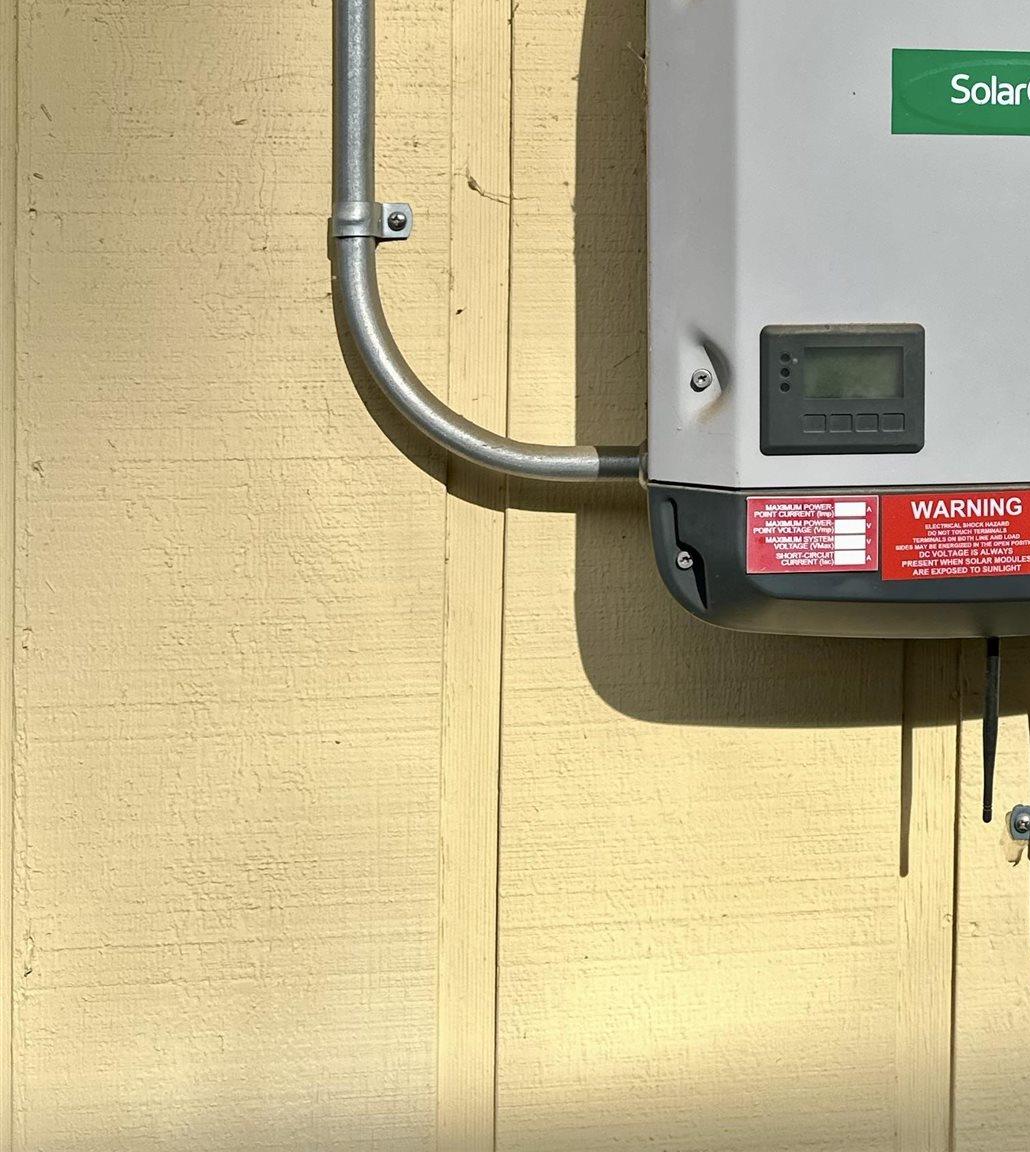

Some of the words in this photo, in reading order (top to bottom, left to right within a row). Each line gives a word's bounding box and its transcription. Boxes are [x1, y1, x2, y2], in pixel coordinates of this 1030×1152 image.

[911, 497, 1022, 519] WARNING
[932, 549, 969, 557] VOLTAGE
[982, 564, 1021, 572] SUNLIGHT
